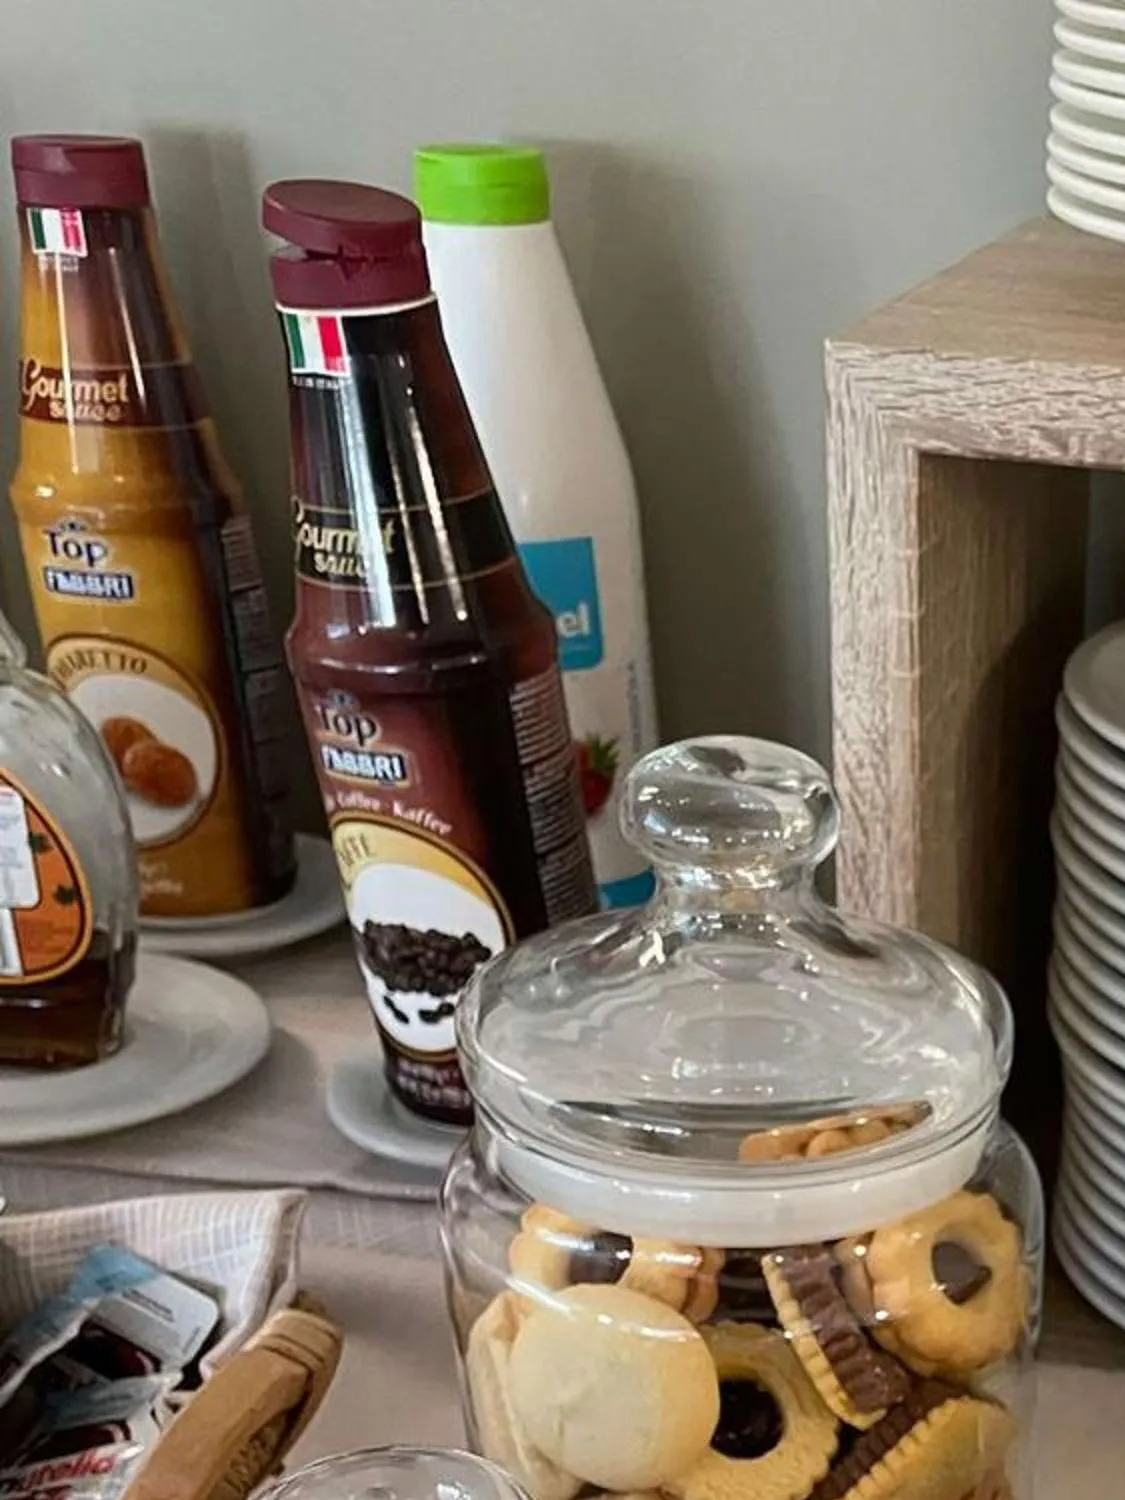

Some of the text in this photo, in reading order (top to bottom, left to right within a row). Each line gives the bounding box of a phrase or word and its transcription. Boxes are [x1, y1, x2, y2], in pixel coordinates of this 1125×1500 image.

[289, 495, 395, 554] ourmt
[44, 526, 108, 568] Top
[313, 551, 366, 578] sauc
[315, 701, 378, 747] Top
